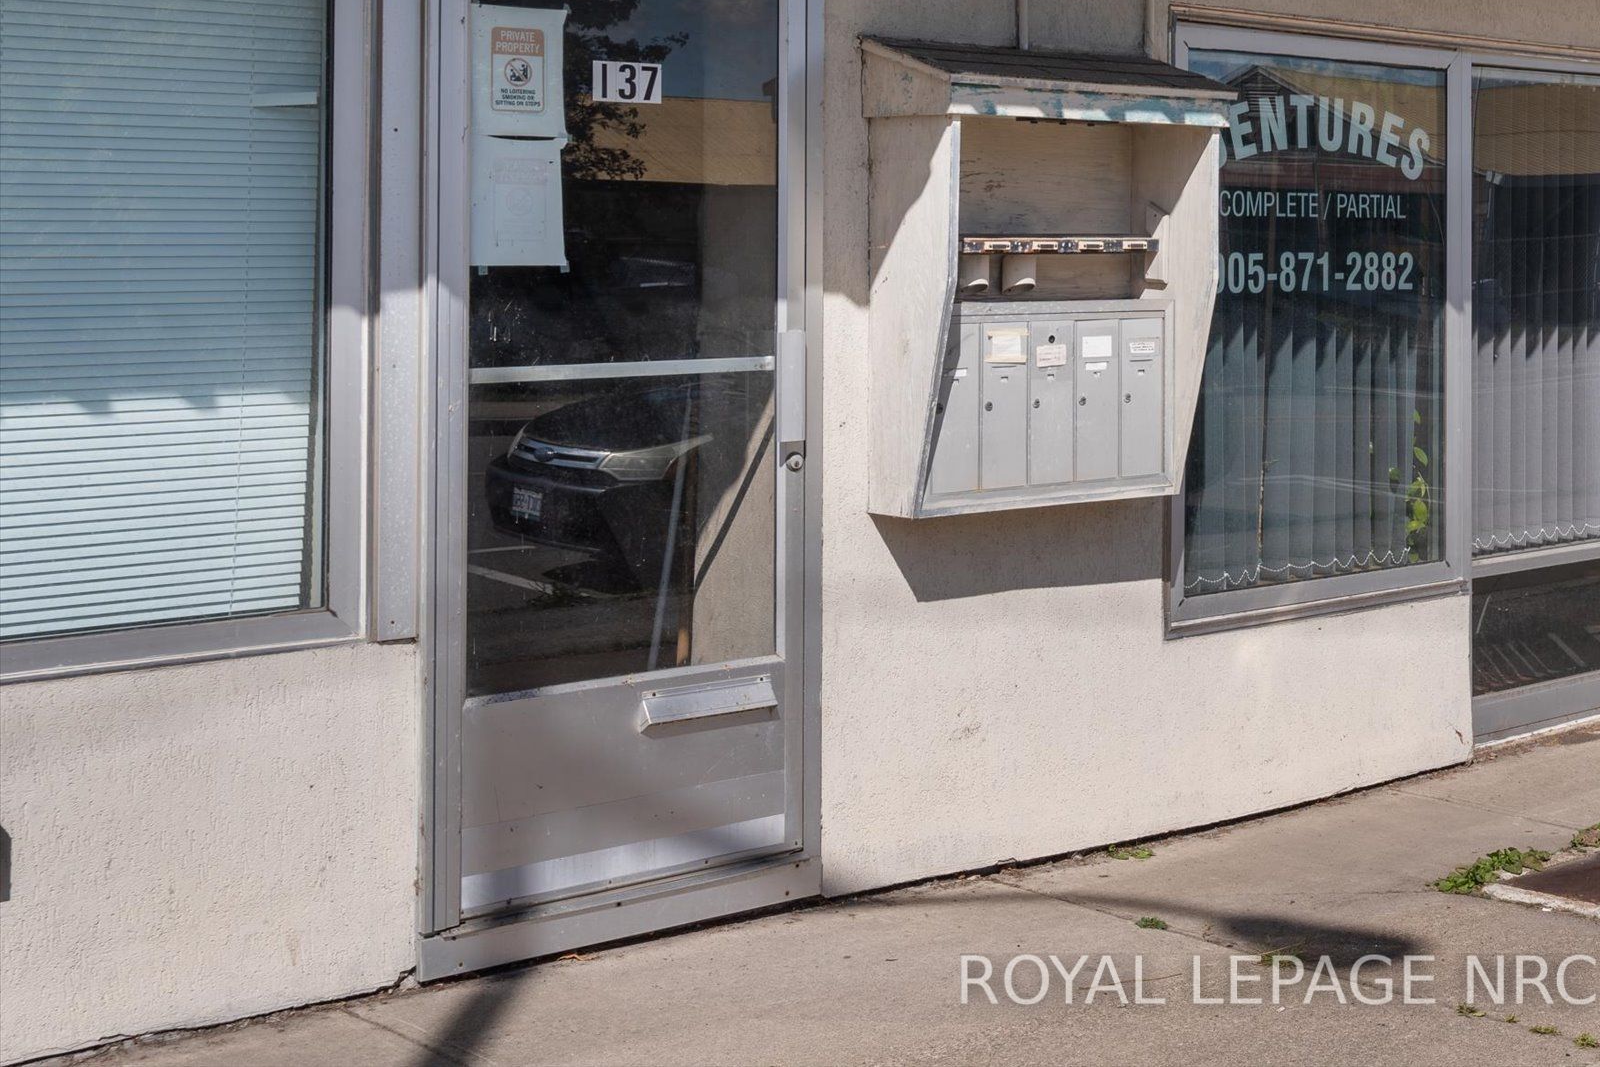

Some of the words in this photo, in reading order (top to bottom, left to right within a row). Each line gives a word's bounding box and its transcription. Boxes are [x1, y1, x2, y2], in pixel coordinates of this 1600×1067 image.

[495, 41, 541, 54] PROPERTY
[501, 30, 536, 43] PRIVATE
[601, 63, 659, 101] 137
[1219, 94, 1430, 181] ENTURES
[1219, 190, 1319, 218] COMPLETE
[1336, 192, 1406, 219] PARTIAL
